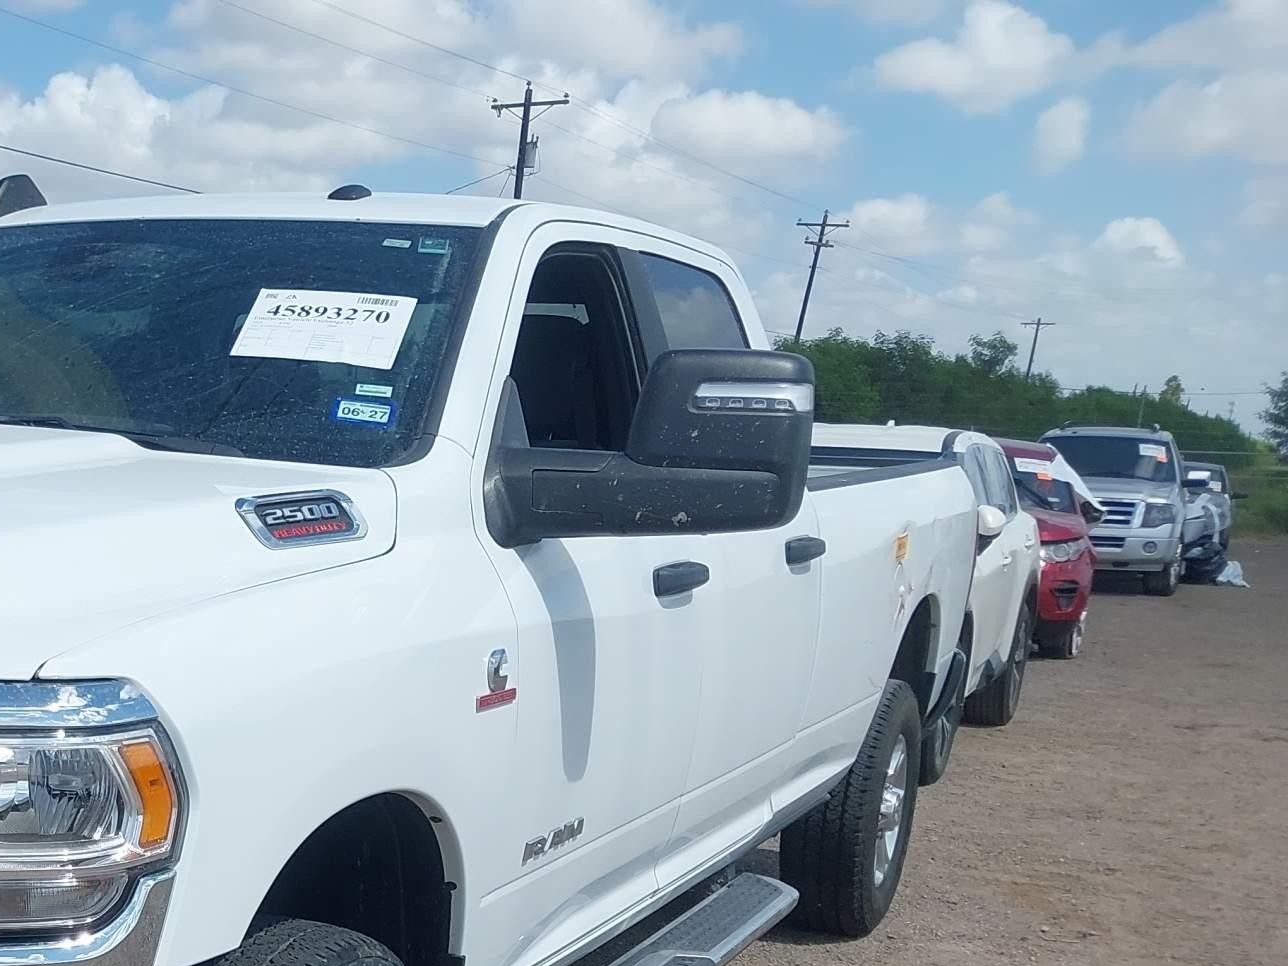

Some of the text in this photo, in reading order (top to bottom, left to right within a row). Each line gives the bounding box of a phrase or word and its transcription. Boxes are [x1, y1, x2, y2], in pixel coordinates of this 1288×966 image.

[266, 303, 391, 324] 45893270
[341, 406, 361, 417] 06
[367, 409, 388, 420] 27
[262, 502, 340, 526] 2500
